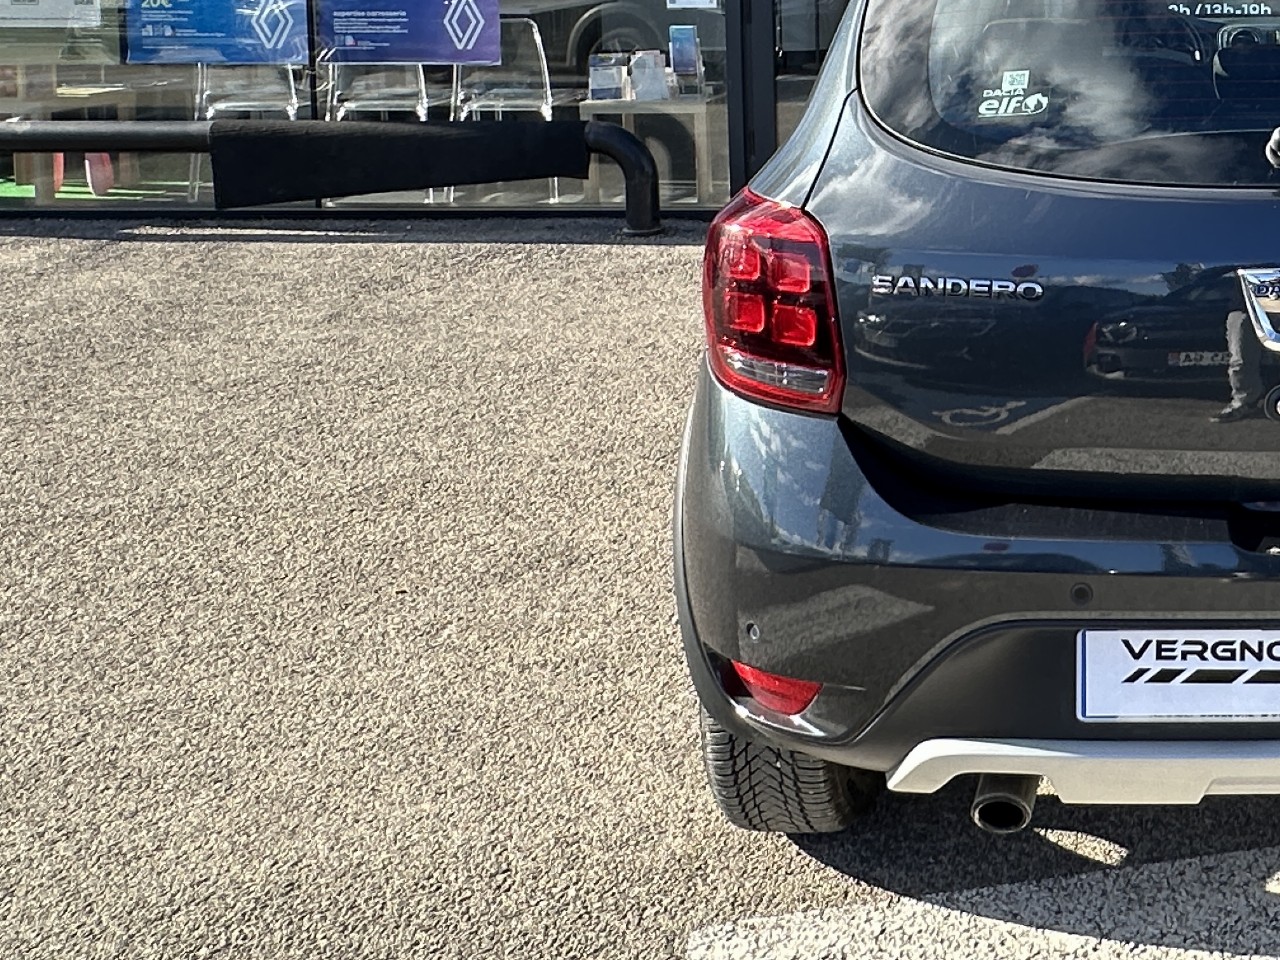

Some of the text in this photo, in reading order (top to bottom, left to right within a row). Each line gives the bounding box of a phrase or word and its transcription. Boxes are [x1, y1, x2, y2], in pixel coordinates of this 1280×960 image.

[983, 88, 1025, 98] DACIA
[978, 96, 1024, 115] elf
[872, 274, 1044, 300] SANDERO
